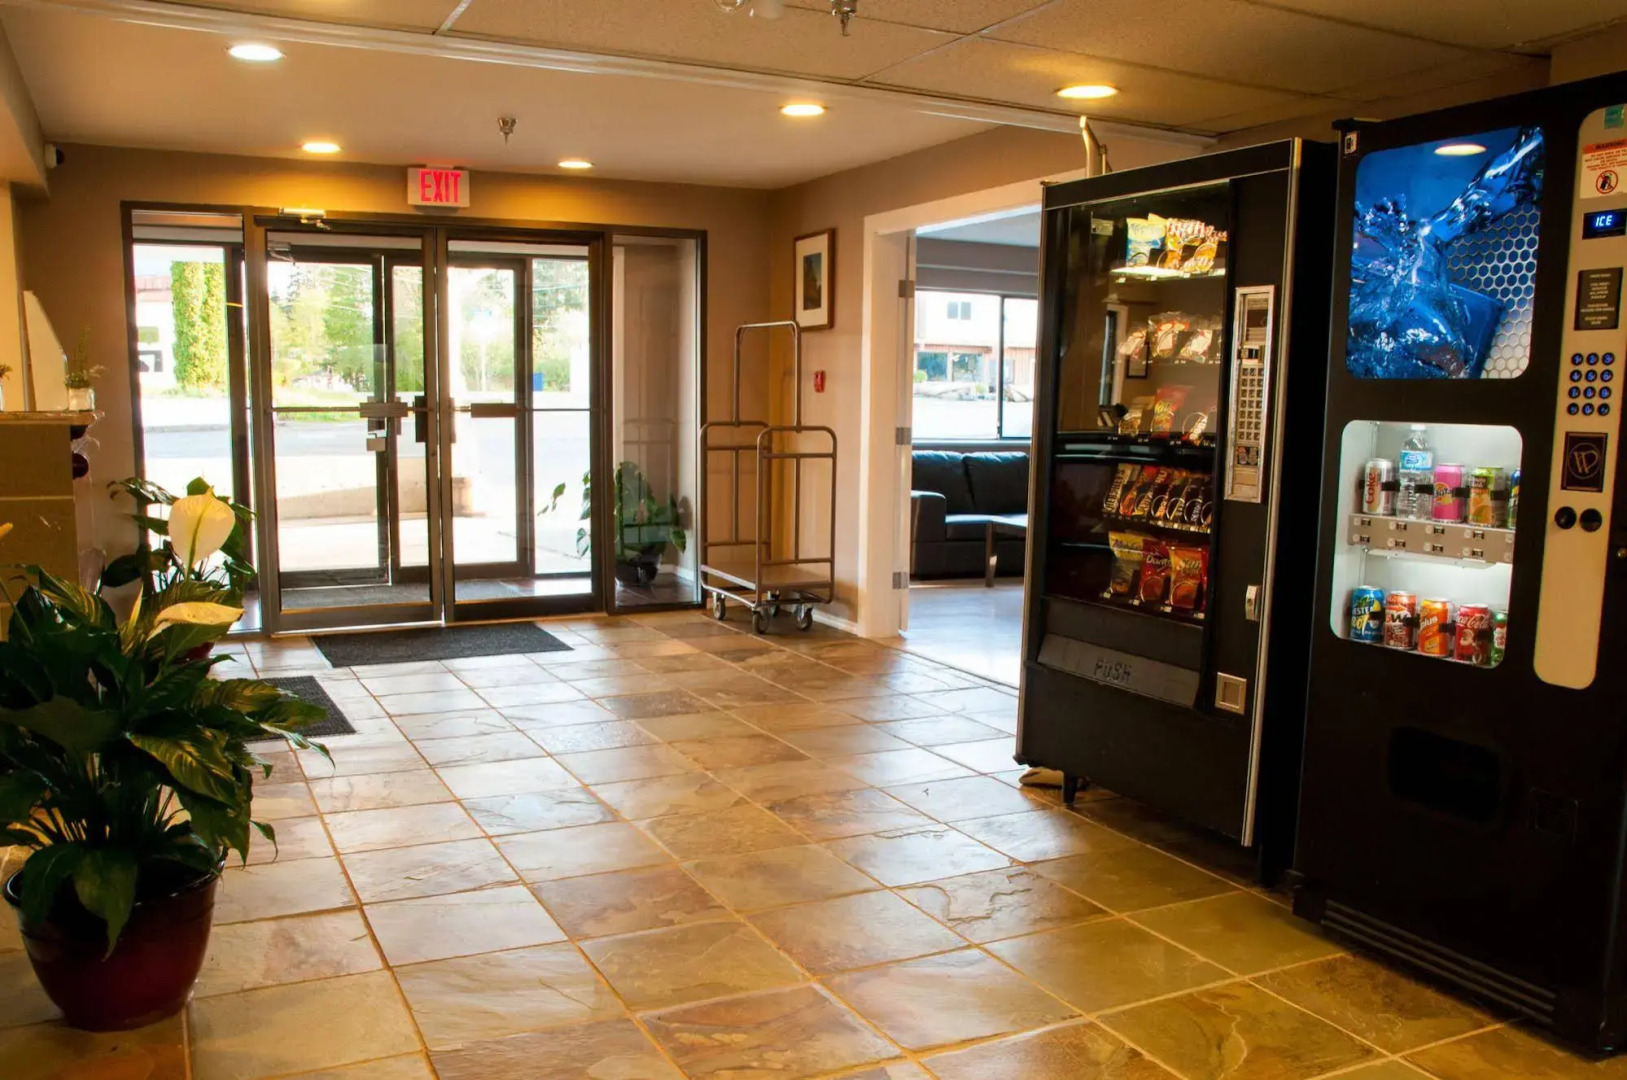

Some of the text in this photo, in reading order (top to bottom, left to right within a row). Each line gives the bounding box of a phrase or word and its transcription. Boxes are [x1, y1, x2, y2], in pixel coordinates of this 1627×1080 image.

[420, 169, 461, 203] EXIT
[1595, 214, 1613, 227] ICE
[1365, 471, 1376, 504] Coke
[1093, 656, 1132, 683] PUSH
